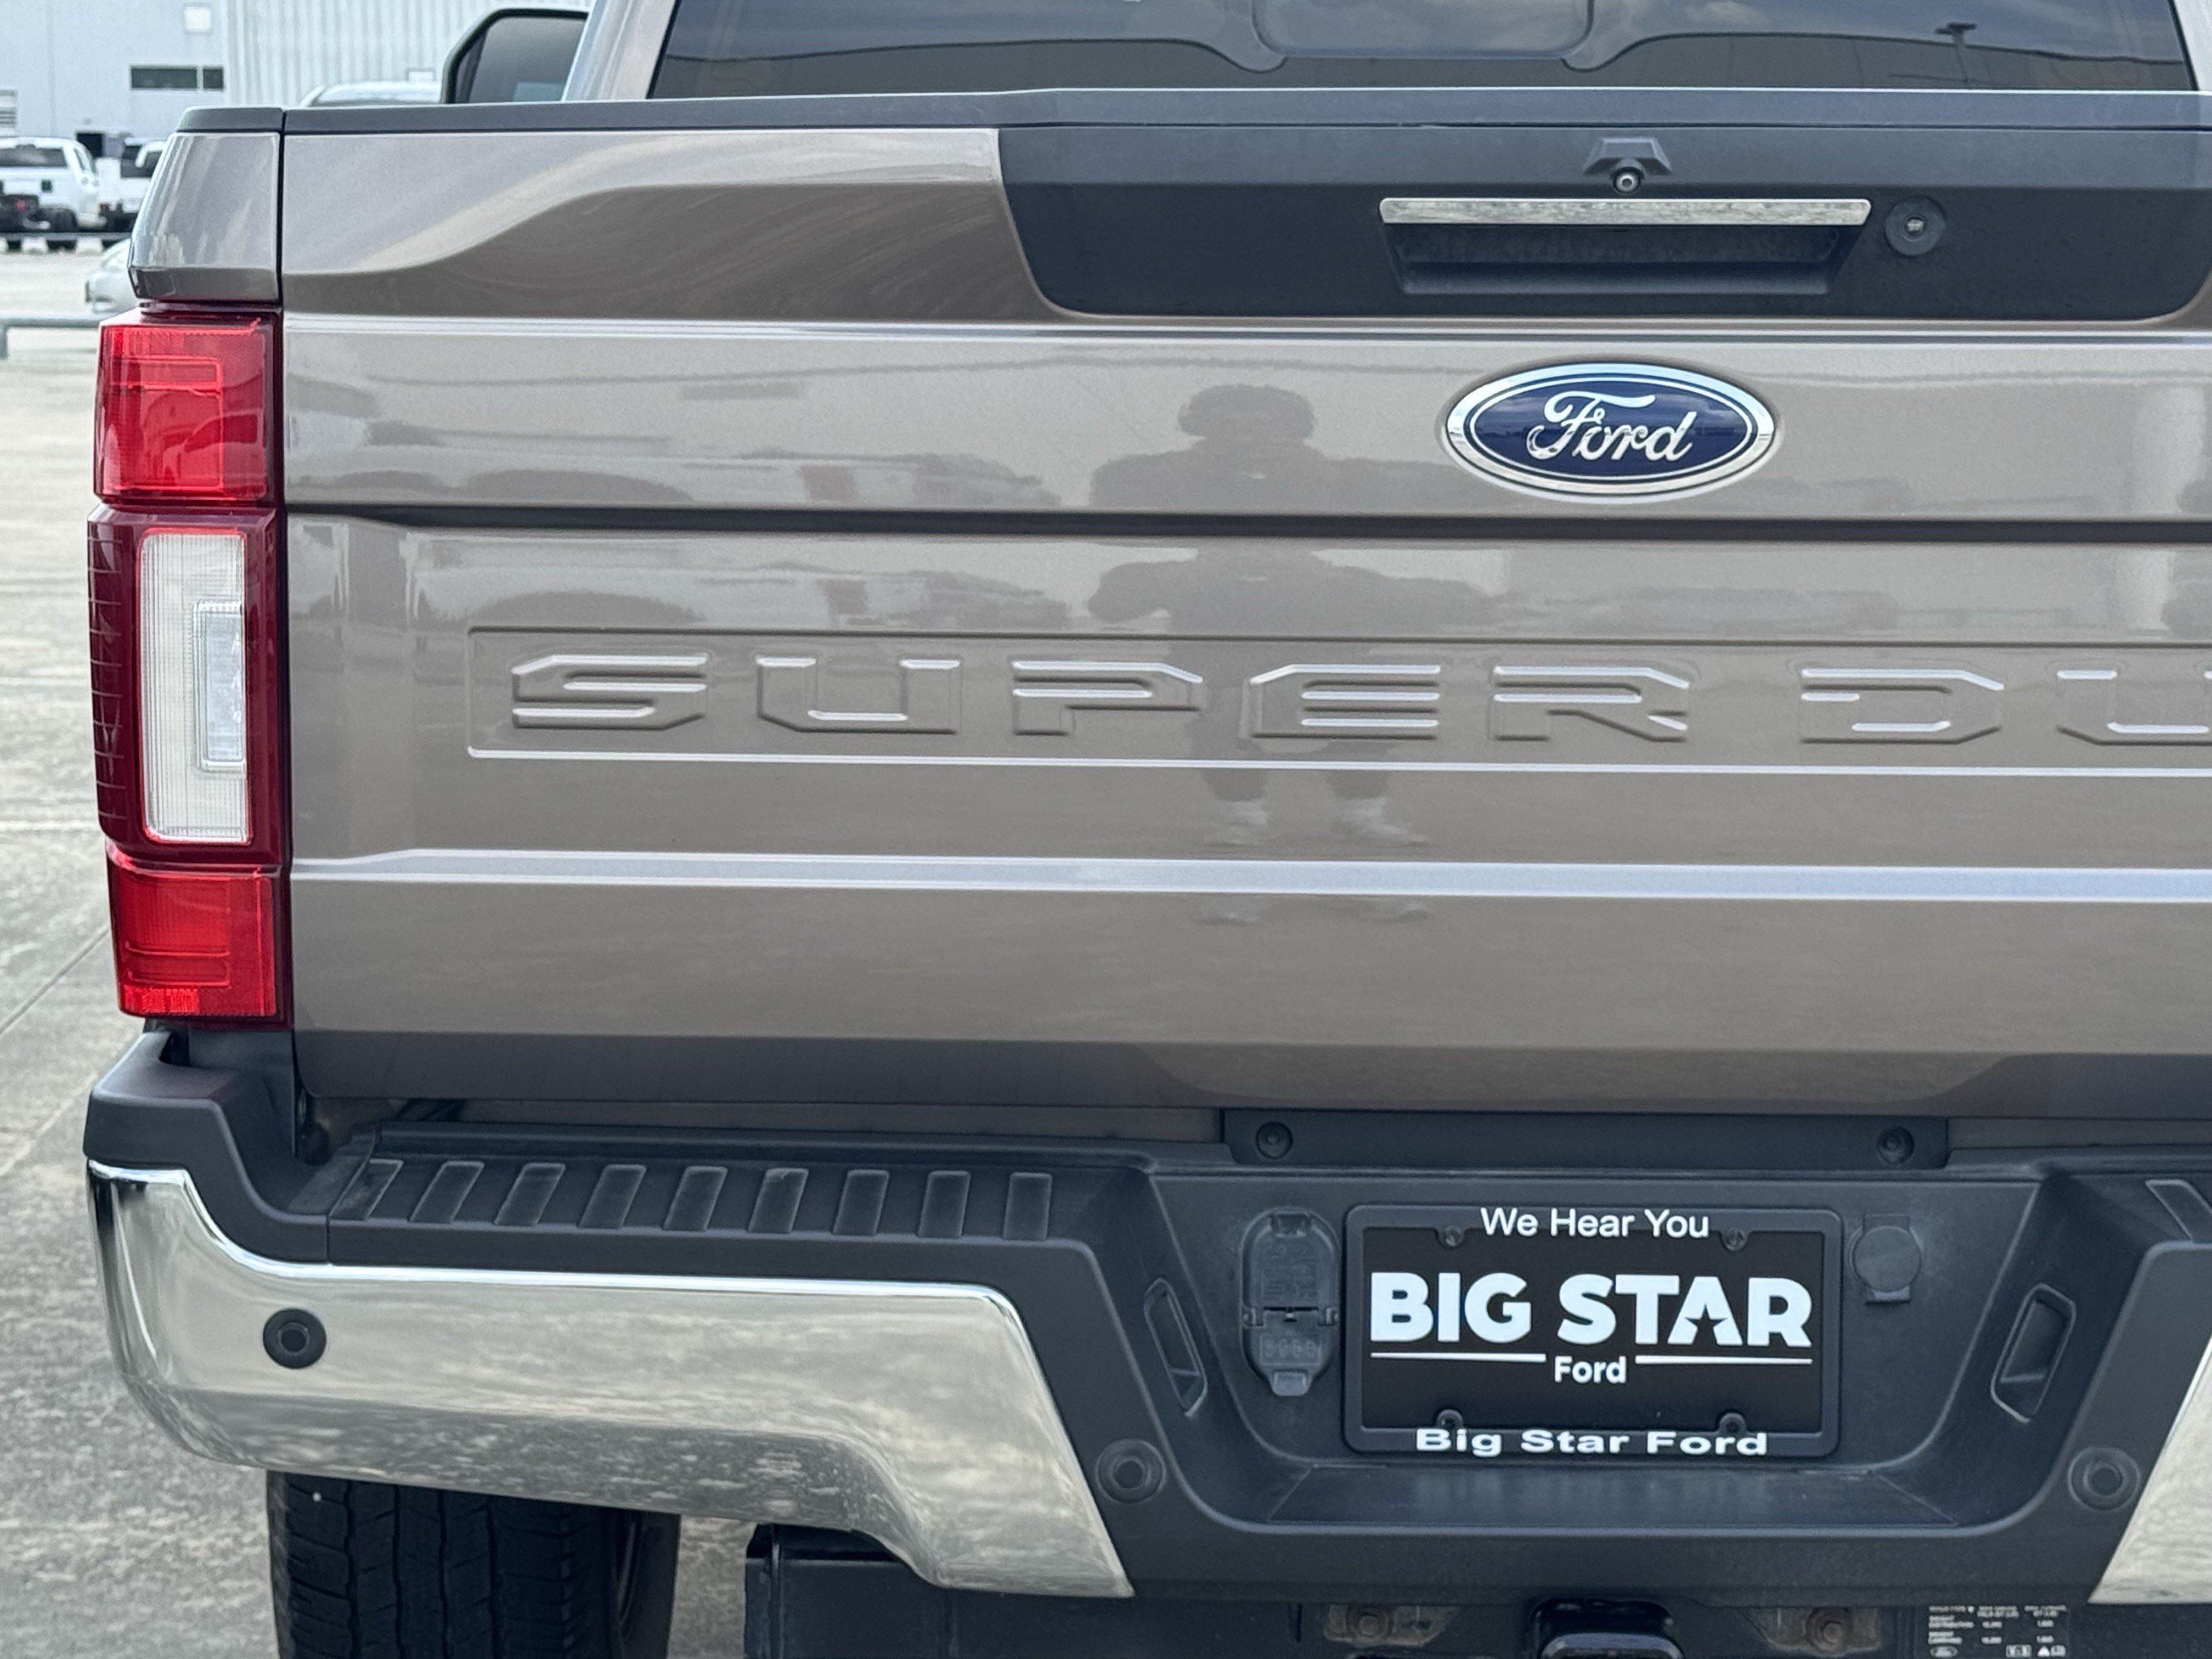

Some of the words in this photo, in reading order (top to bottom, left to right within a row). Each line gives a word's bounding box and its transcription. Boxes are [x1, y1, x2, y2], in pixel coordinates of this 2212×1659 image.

[1526, 390, 1697, 461] Ford
[511, 652, 1690, 743] SUPER
[1480, 1207, 1538, 1237] We
[1550, 1207, 1636, 1238] Hear
[1644, 1208, 1709, 1238] You
[1370, 1272, 1532, 1344] BIG
[1556, 1273, 1813, 1348] STAR
[1554, 1355, 1627, 1384] Ford
[1415, 1428, 1502, 1457] Big
[1520, 1429, 1630, 1454] Star
[1647, 1431, 1767, 1455] Ford
